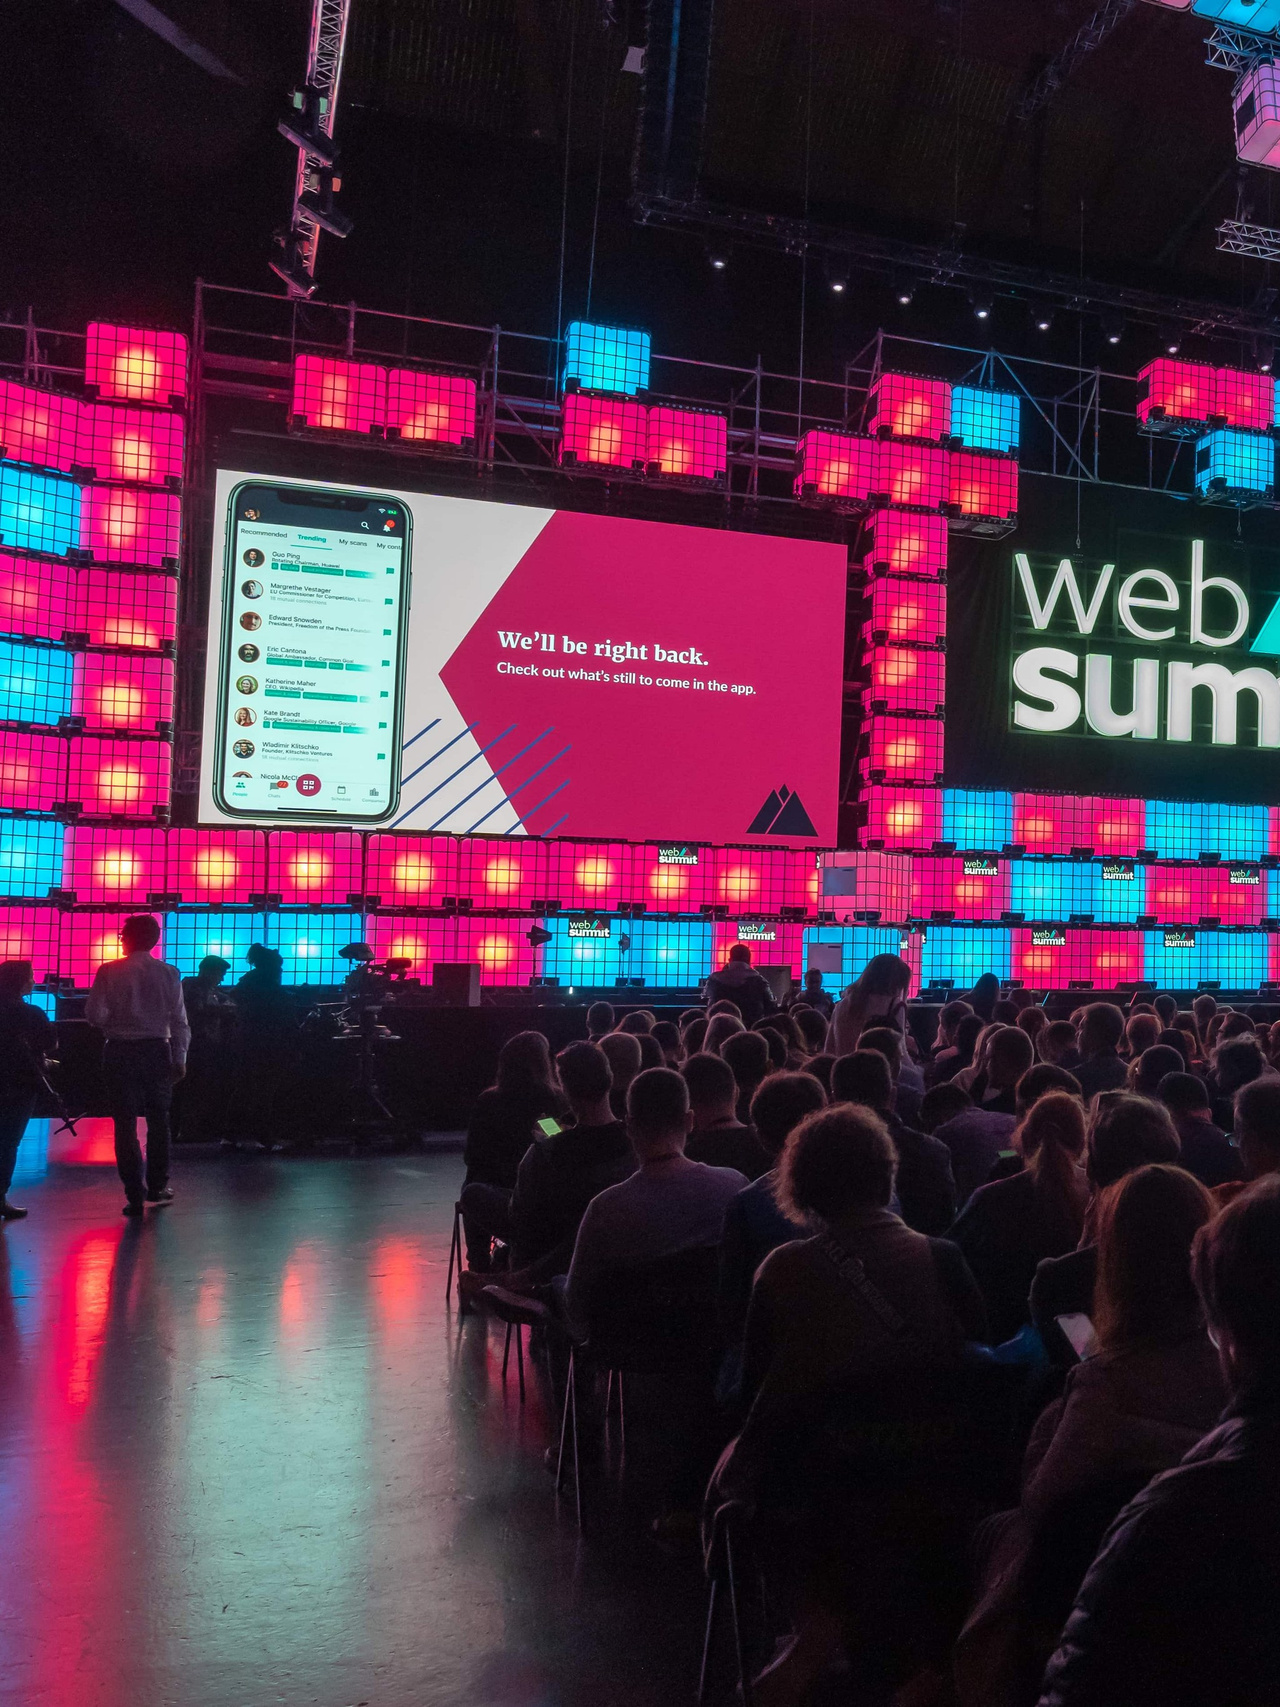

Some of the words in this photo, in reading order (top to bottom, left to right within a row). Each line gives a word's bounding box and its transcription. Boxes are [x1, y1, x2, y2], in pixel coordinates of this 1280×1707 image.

[240, 528, 288, 538] Recommended
[297, 534, 327, 543] Trending
[339, 538, 349, 546] My
[286, 552, 301, 560] Ping
[270, 582, 302, 591] Margrethe
[303, 585, 331, 594] Vestager
[279, 589, 315, 598] Commissioner
[1015, 539, 1250, 648] web
[268, 614, 293, 622] Edward
[293, 616, 322, 624] Snowden
[268, 620, 295, 628] President,
[280, 647, 307, 655] Cantona
[562, 635, 588, 655] be
[594, 639, 648, 663] right
[654, 644, 709, 666] back.
[265, 677, 296, 686] Katherine
[296, 679, 316, 687] Maher
[497, 661, 538, 676] Check
[542, 667, 565, 679] out
[613, 672, 636, 685] still
[639, 675, 653, 686] to
[655, 677, 690, 690] come
[692, 678, 705, 691] in
[707, 679, 728, 692] the
[730, 684, 757, 696] app.
[279, 710, 301, 718] Brandt
[262, 741, 290, 749] Wladimir
[291, 743, 319, 751] Klitschko
[659, 847, 680, 857] web
[658, 855, 698, 864] summit
[964, 859, 982, 868] web
[964, 867, 998, 875] summit
[1103, 864, 1119, 873] web
[1230, 869, 1246, 877] web
[1103, 872, 1134, 880] summit
[1230, 876, 1259, 884] summit
[569, 919, 591, 929] web
[738, 923, 758, 933] web
[569, 928, 610, 937] summit
[738, 932, 776, 941] summit
[1033, 930, 1050, 938] web
[1165, 932, 1181, 940] web
[1032, 937, 1066, 945] summit
[1164, 939, 1195, 947] summit
